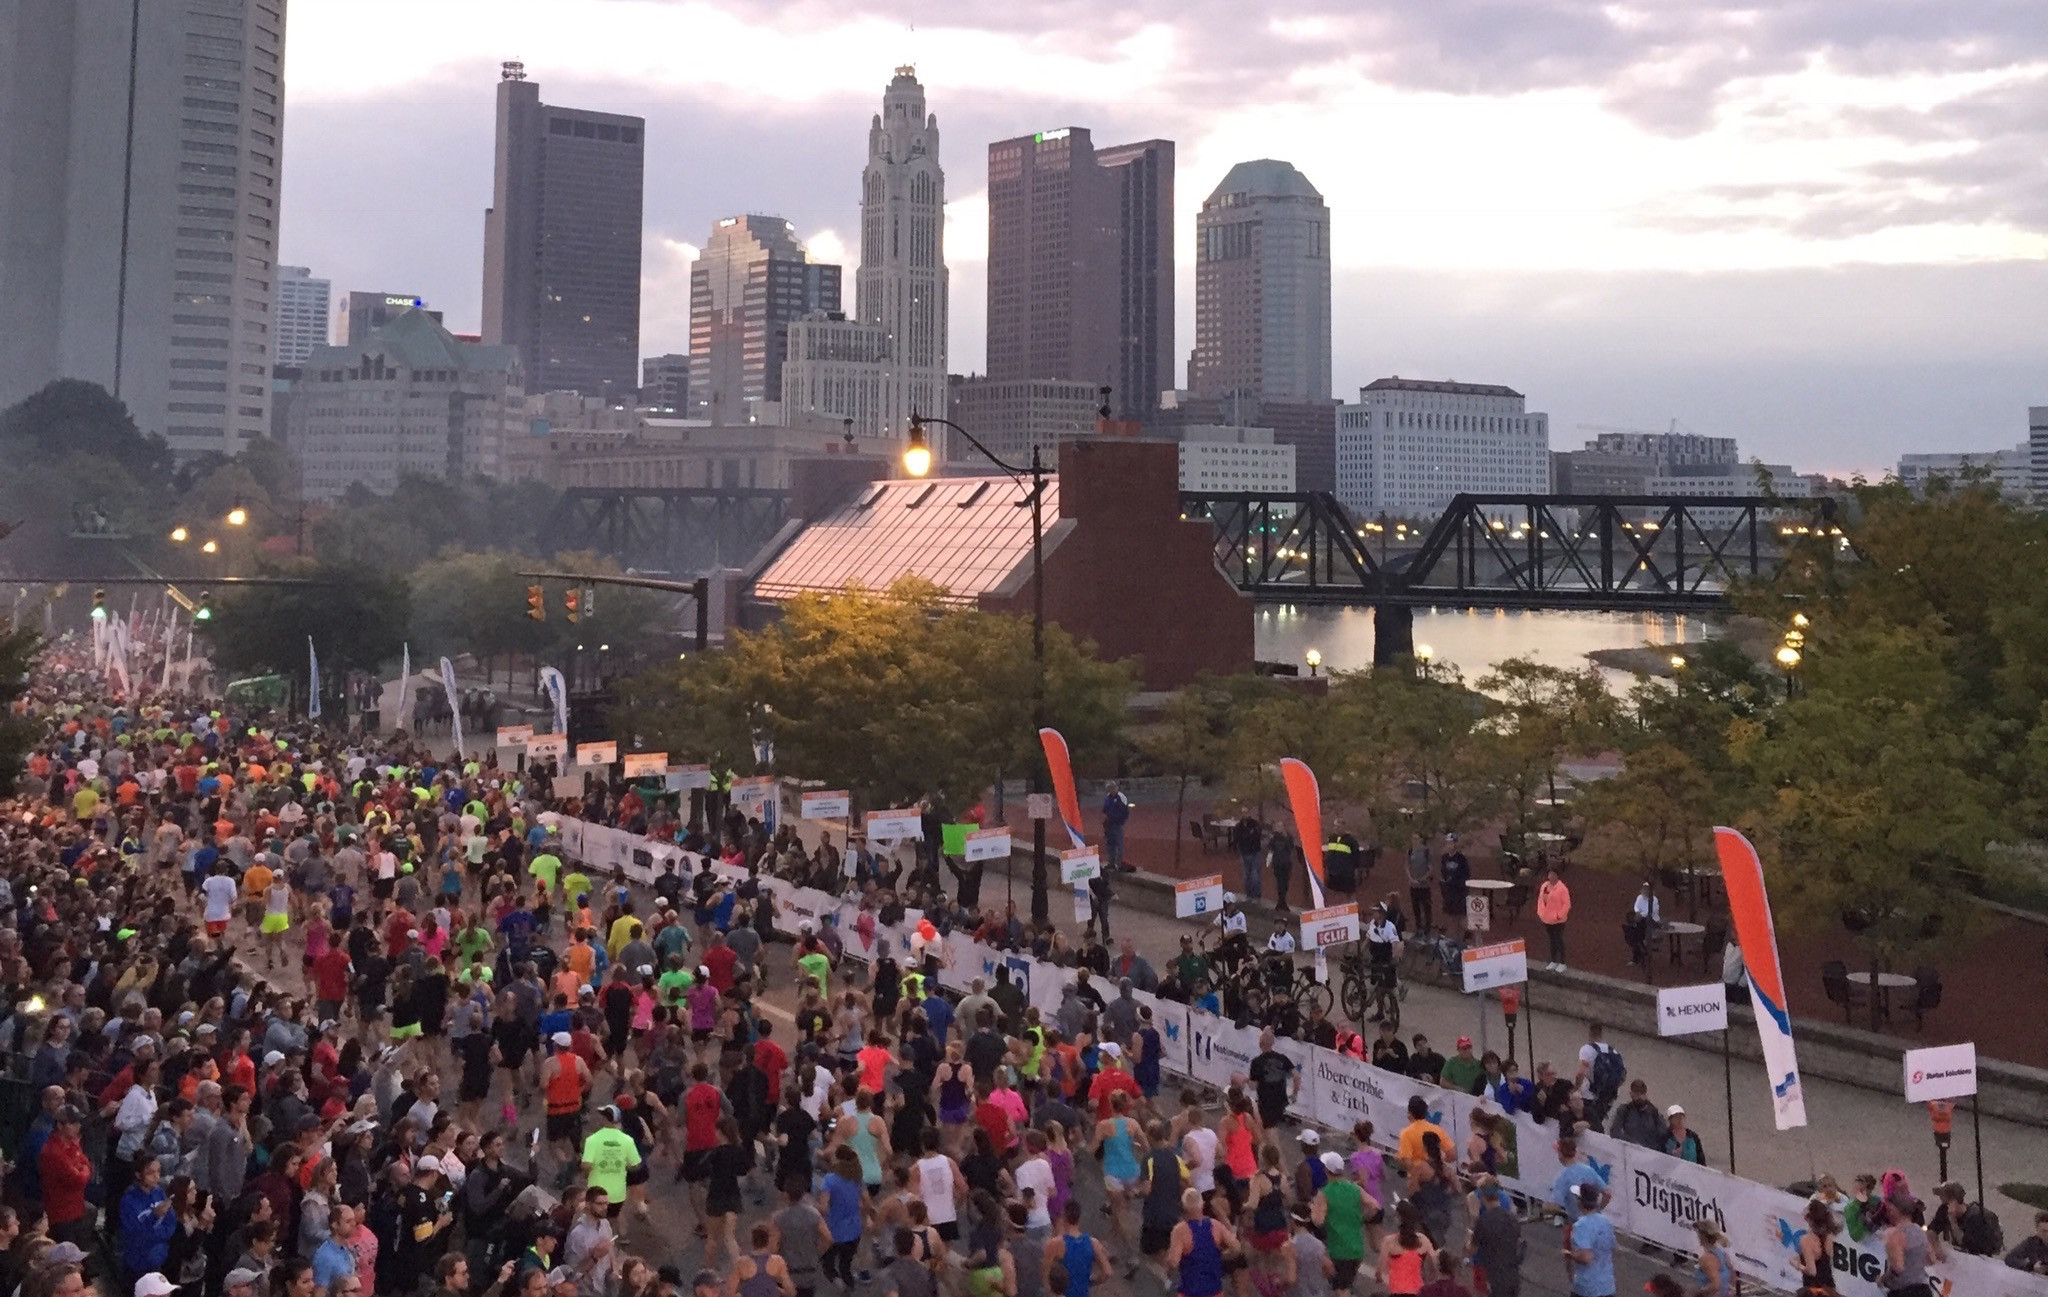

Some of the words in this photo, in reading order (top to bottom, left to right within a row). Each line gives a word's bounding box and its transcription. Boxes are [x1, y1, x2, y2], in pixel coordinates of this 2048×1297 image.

[386, 297, 414, 306] CHASE
[1323, 929, 1347, 944] CLIF
[1678, 1002, 1720, 1015] HEXION
[1213, 1042, 1250, 1063] Nationwide
[1945, 1068, 1972, 1078] Solutions
[1331, 1091, 1340, 1105] &
[1343, 1090, 1370, 1115] Fitch
[418, 1191, 427, 1203] 3
[1633, 1168, 1727, 1233] Dispatch
[1833, 1242, 1881, 1283] BIG
